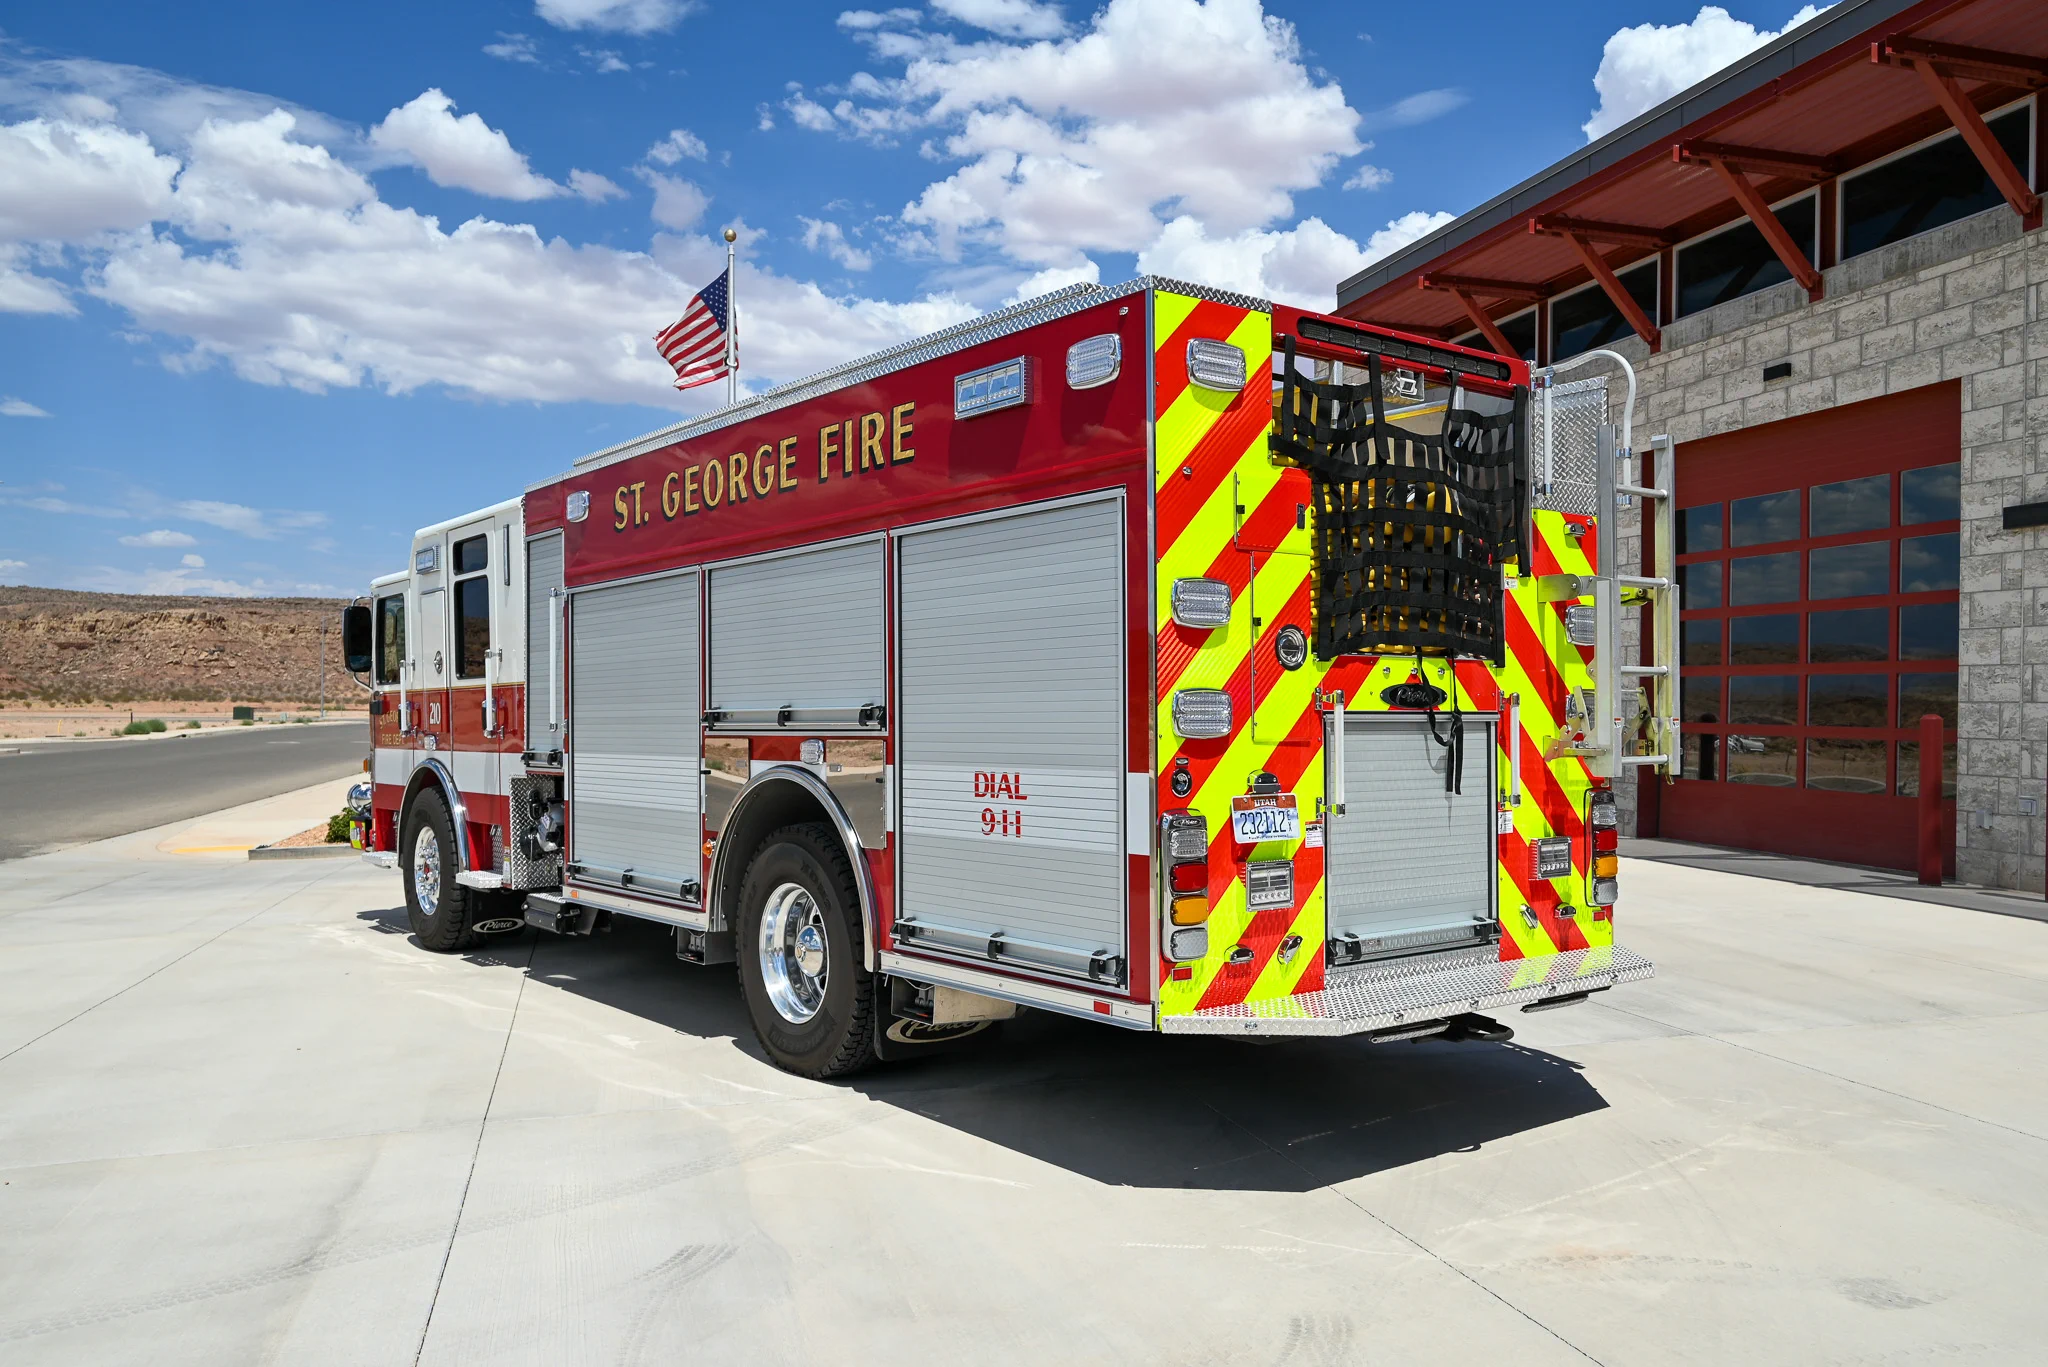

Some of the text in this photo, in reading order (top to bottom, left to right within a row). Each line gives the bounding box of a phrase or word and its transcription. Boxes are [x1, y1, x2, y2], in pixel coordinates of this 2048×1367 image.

[613, 400, 915, 532] ST. GEORGE FIRE
[429, 702, 441, 725] 210
[974, 770, 1028, 800] DIAL
[1254, 798, 1277, 807] UTAH
[981, 807, 1021, 838] 9-1-1
[1240, 810, 1287, 835] 232112
[483, 920, 513, 932] Pierce
